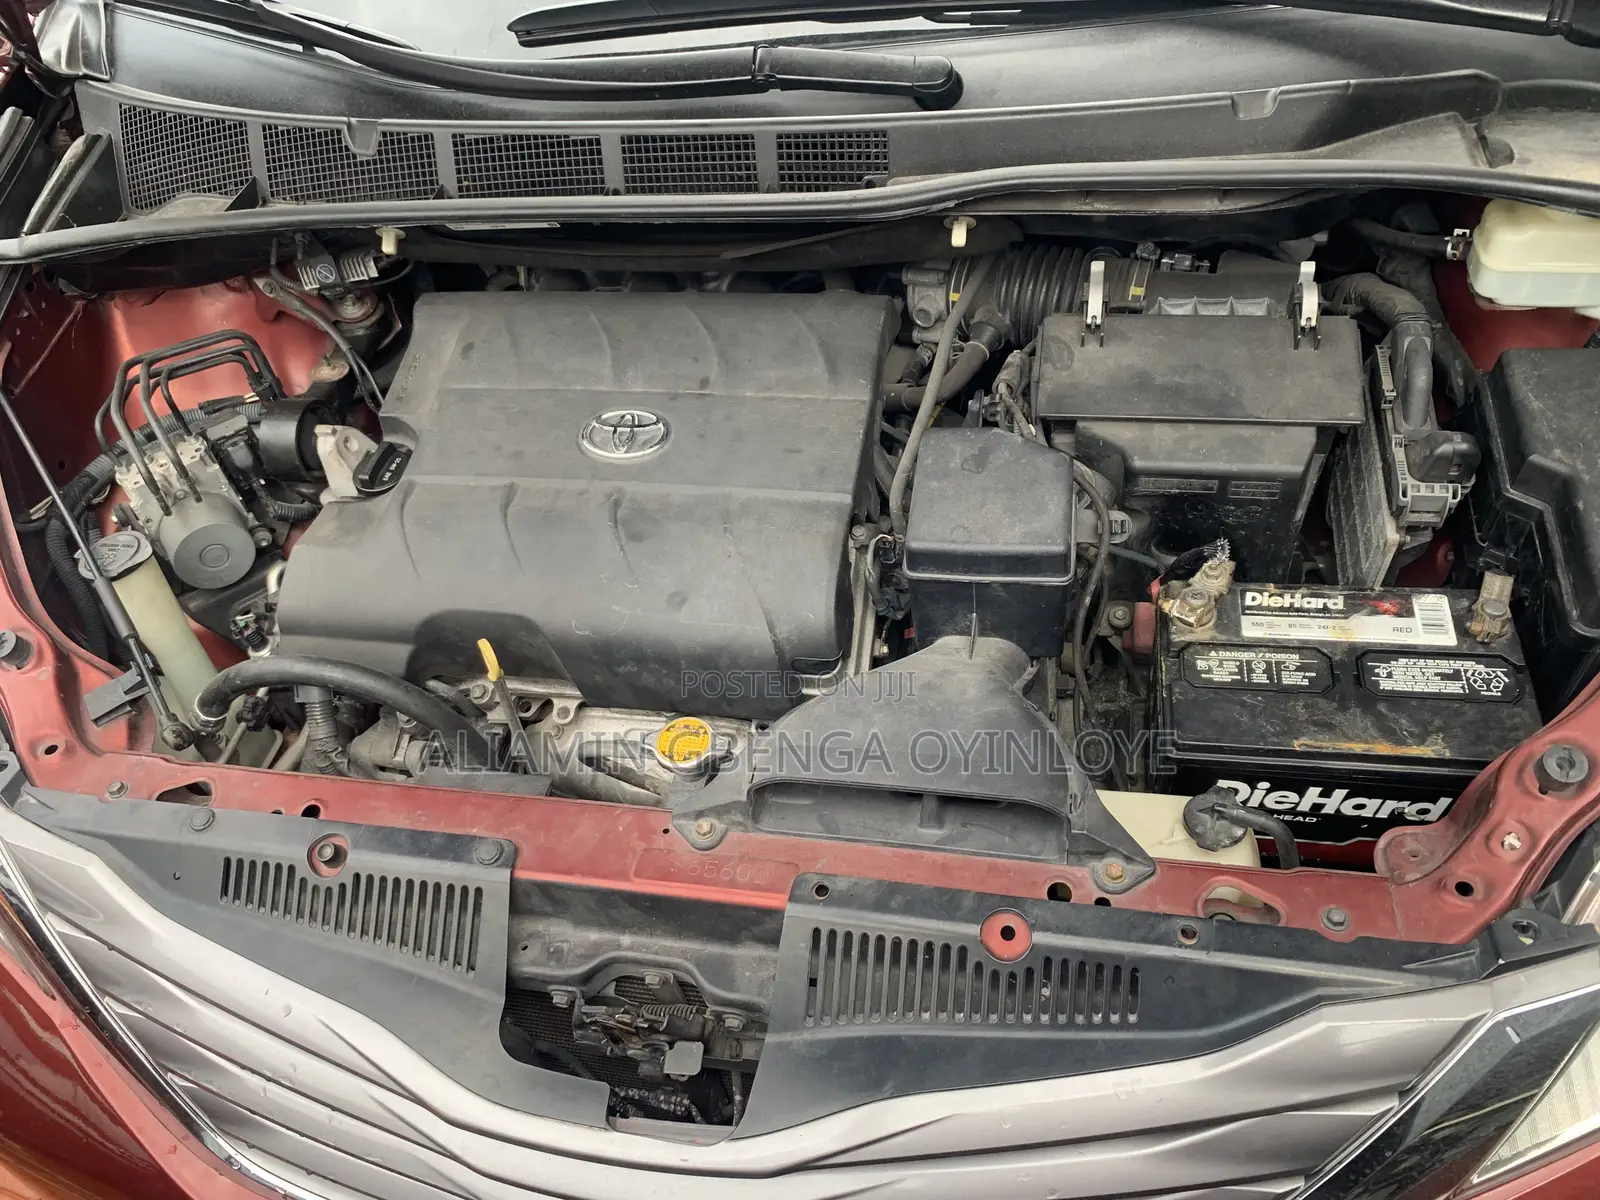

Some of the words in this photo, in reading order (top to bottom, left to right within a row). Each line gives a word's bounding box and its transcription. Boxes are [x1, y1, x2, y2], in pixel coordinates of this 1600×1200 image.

[1244, 592, 1344, 609] DieHard
[1392, 626, 1413, 634] RED
[1265, 652, 1300, 660] POISON
